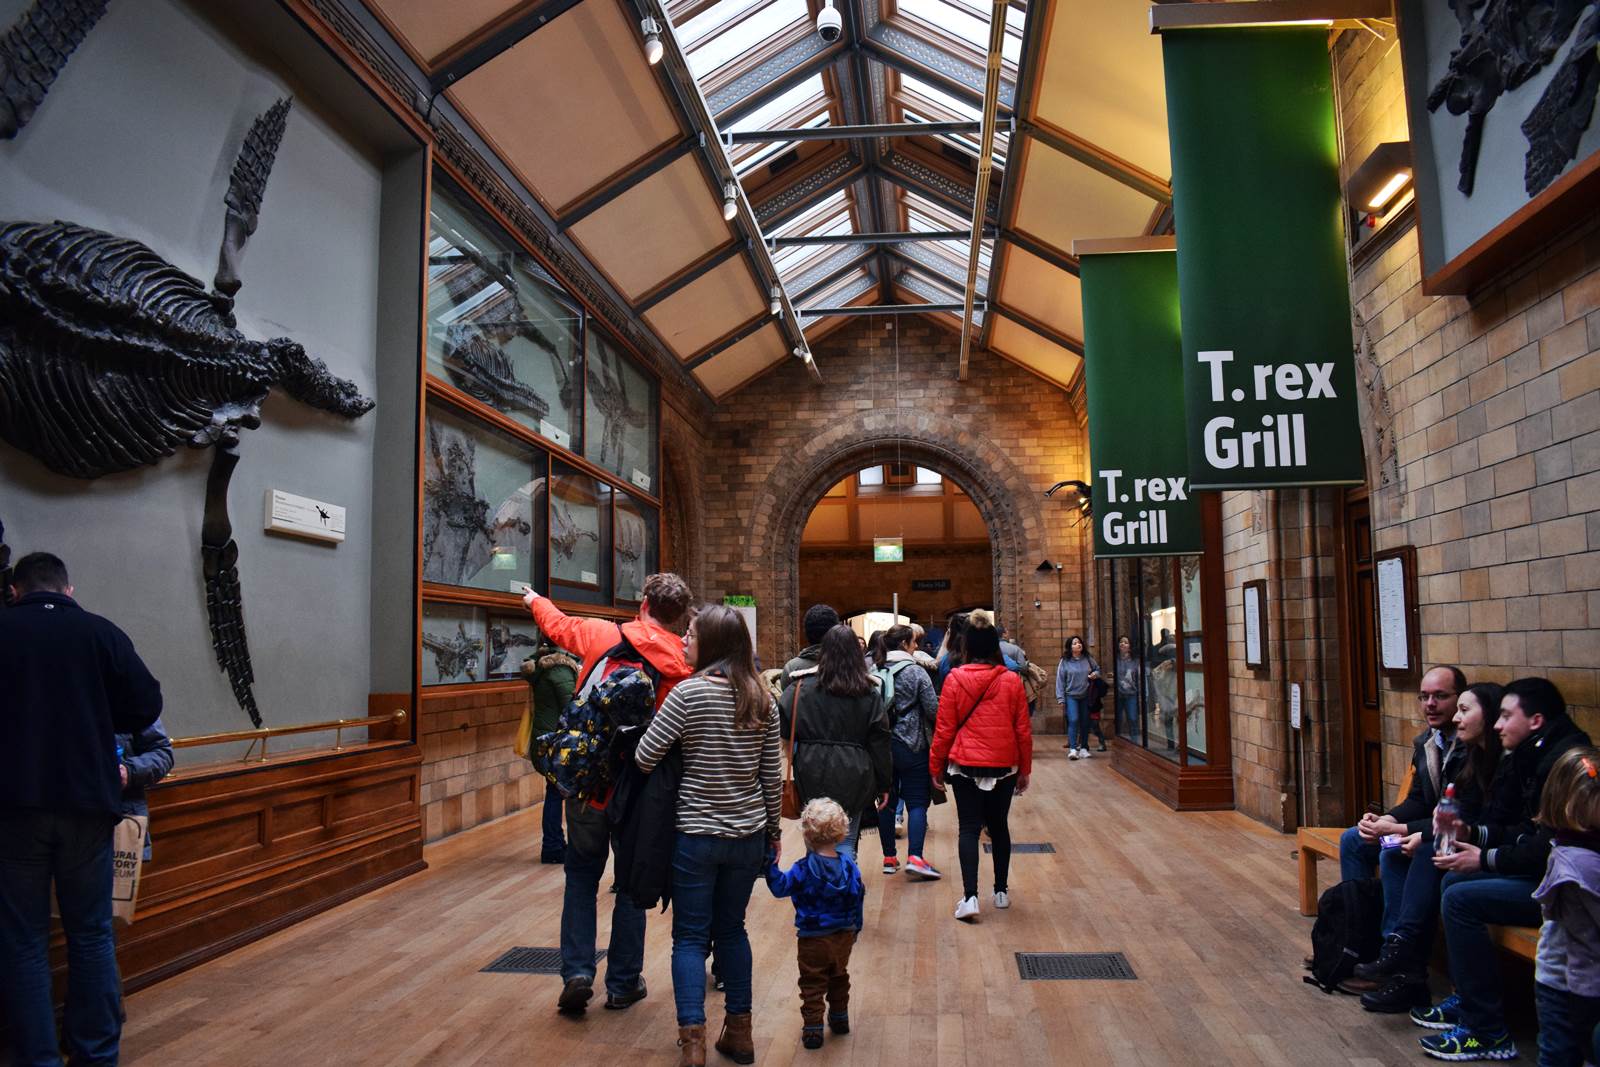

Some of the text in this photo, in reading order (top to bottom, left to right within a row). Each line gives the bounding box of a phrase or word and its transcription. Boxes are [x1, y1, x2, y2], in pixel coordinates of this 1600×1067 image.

[1253, 362, 1338, 401] rex
[1203, 413, 1307, 469] Grill
[1134, 476, 1188, 503] rex
[1102, 509, 1168, 546] Grill
